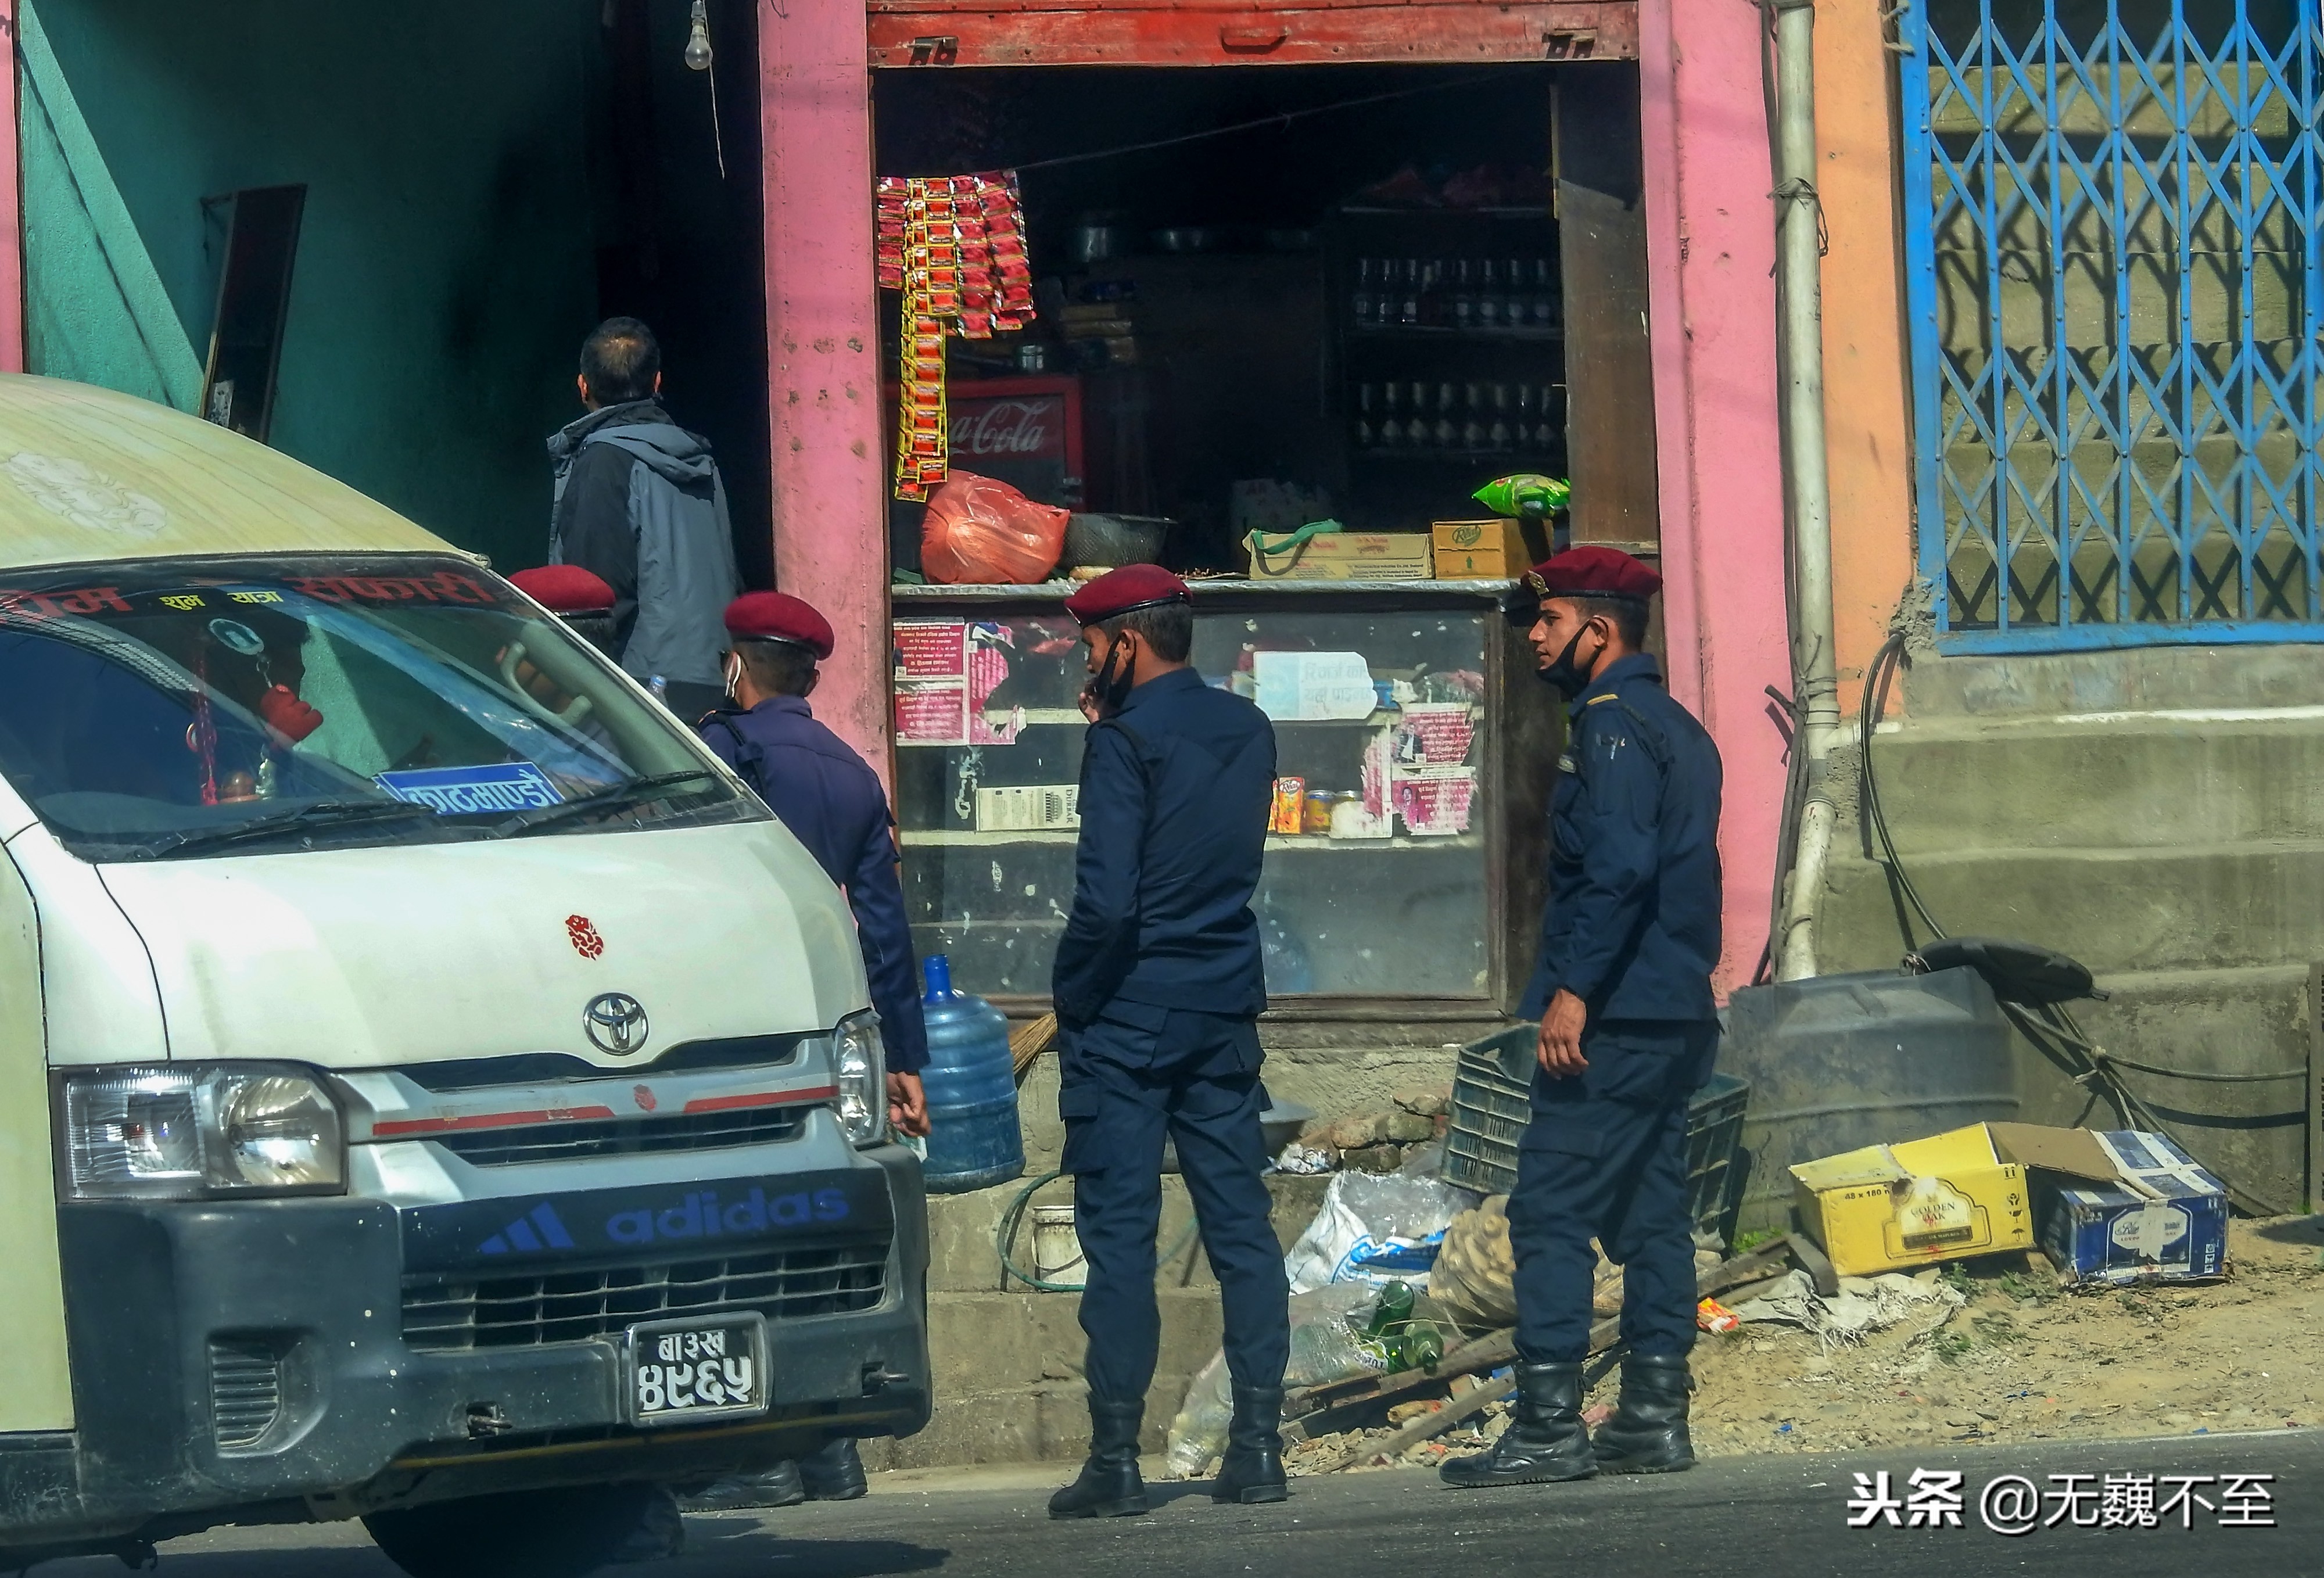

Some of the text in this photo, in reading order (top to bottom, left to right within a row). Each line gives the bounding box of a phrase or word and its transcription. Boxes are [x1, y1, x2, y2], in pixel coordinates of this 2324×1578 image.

[159, 594, 206, 611] शुभ
[1066, 789, 1074, 824] DURBAR
[606, 1187, 849, 1243] adidas
[1911, 1202, 1955, 1218] GOLDEN
